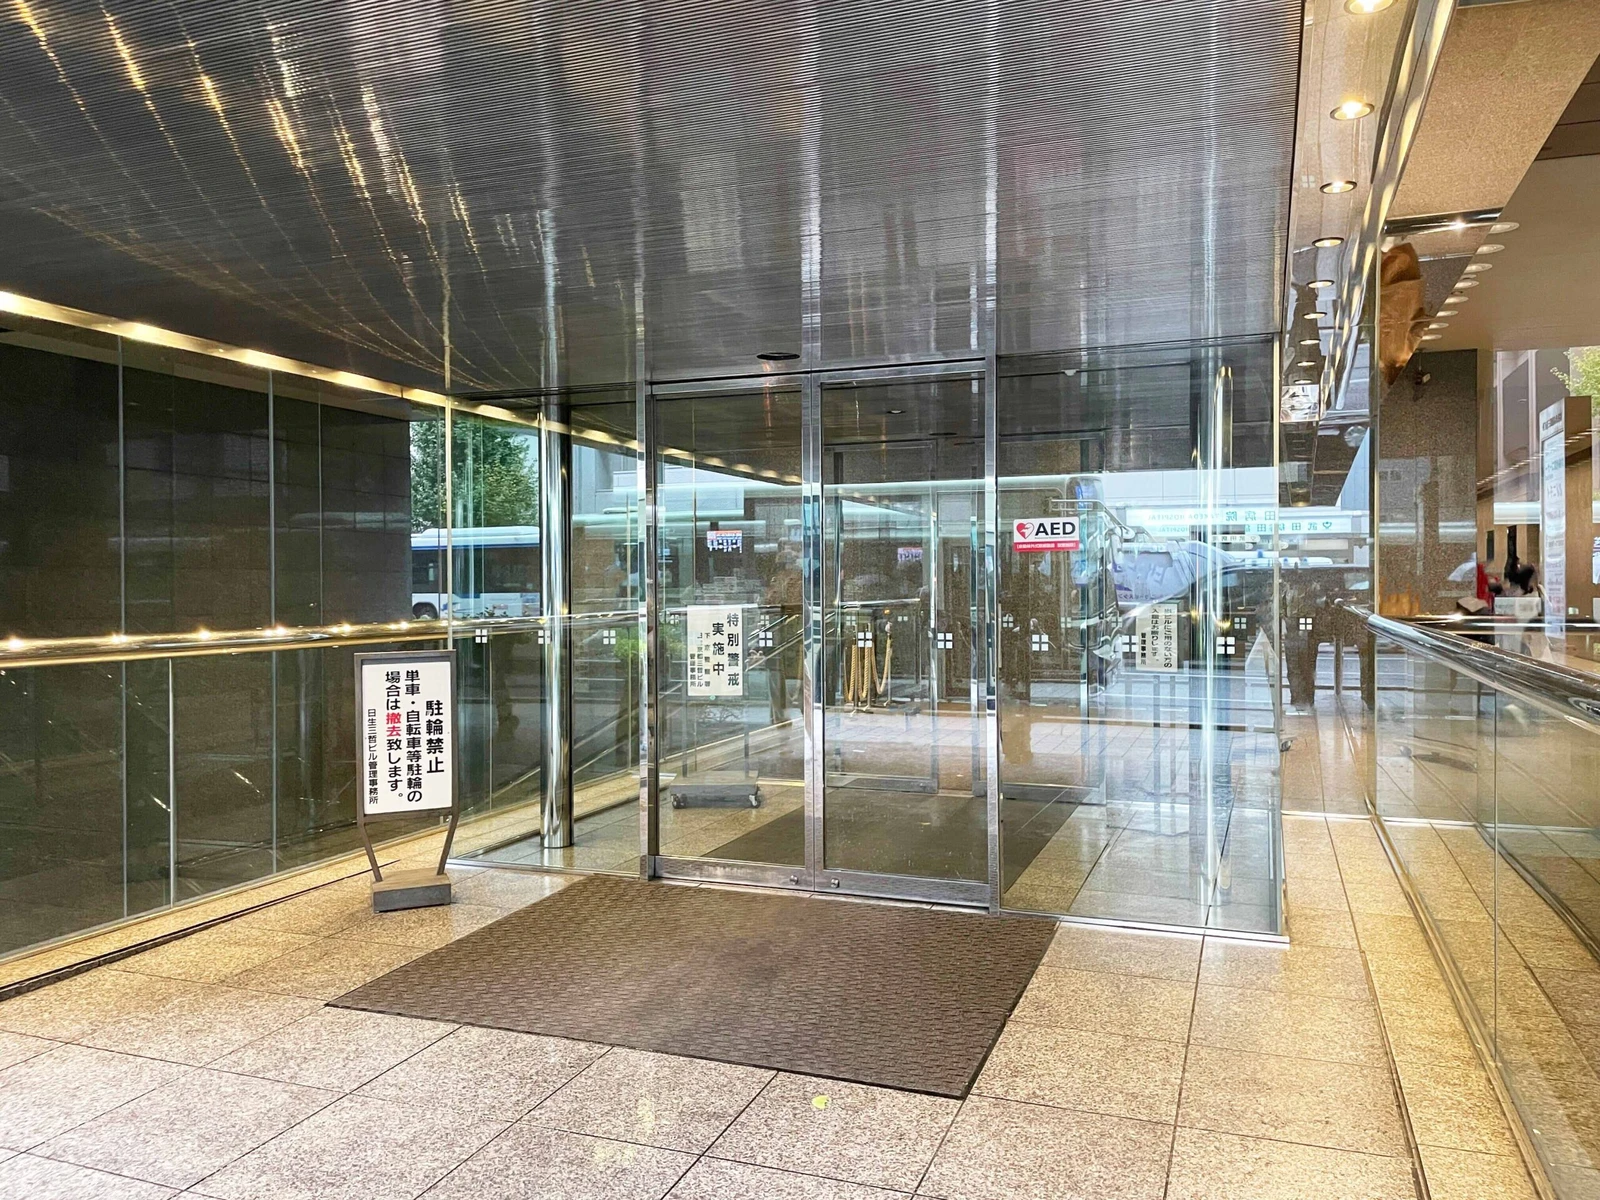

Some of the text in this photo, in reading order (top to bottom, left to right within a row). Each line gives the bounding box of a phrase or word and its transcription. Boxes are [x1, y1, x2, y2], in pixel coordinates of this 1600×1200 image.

[1034, 521, 1076, 536] AED
[712, 622, 725, 676] 実施中
[726, 613, 740, 686] 特別警戒
[367, 708, 379, 805] 日生三哲ビル管理事務所
[385, 670, 403, 798] 場合は撤去致します。
[404, 669, 423, 803] 単車・自転車等駐輪の
[425, 699, 444, 774] 駐輪禁止
